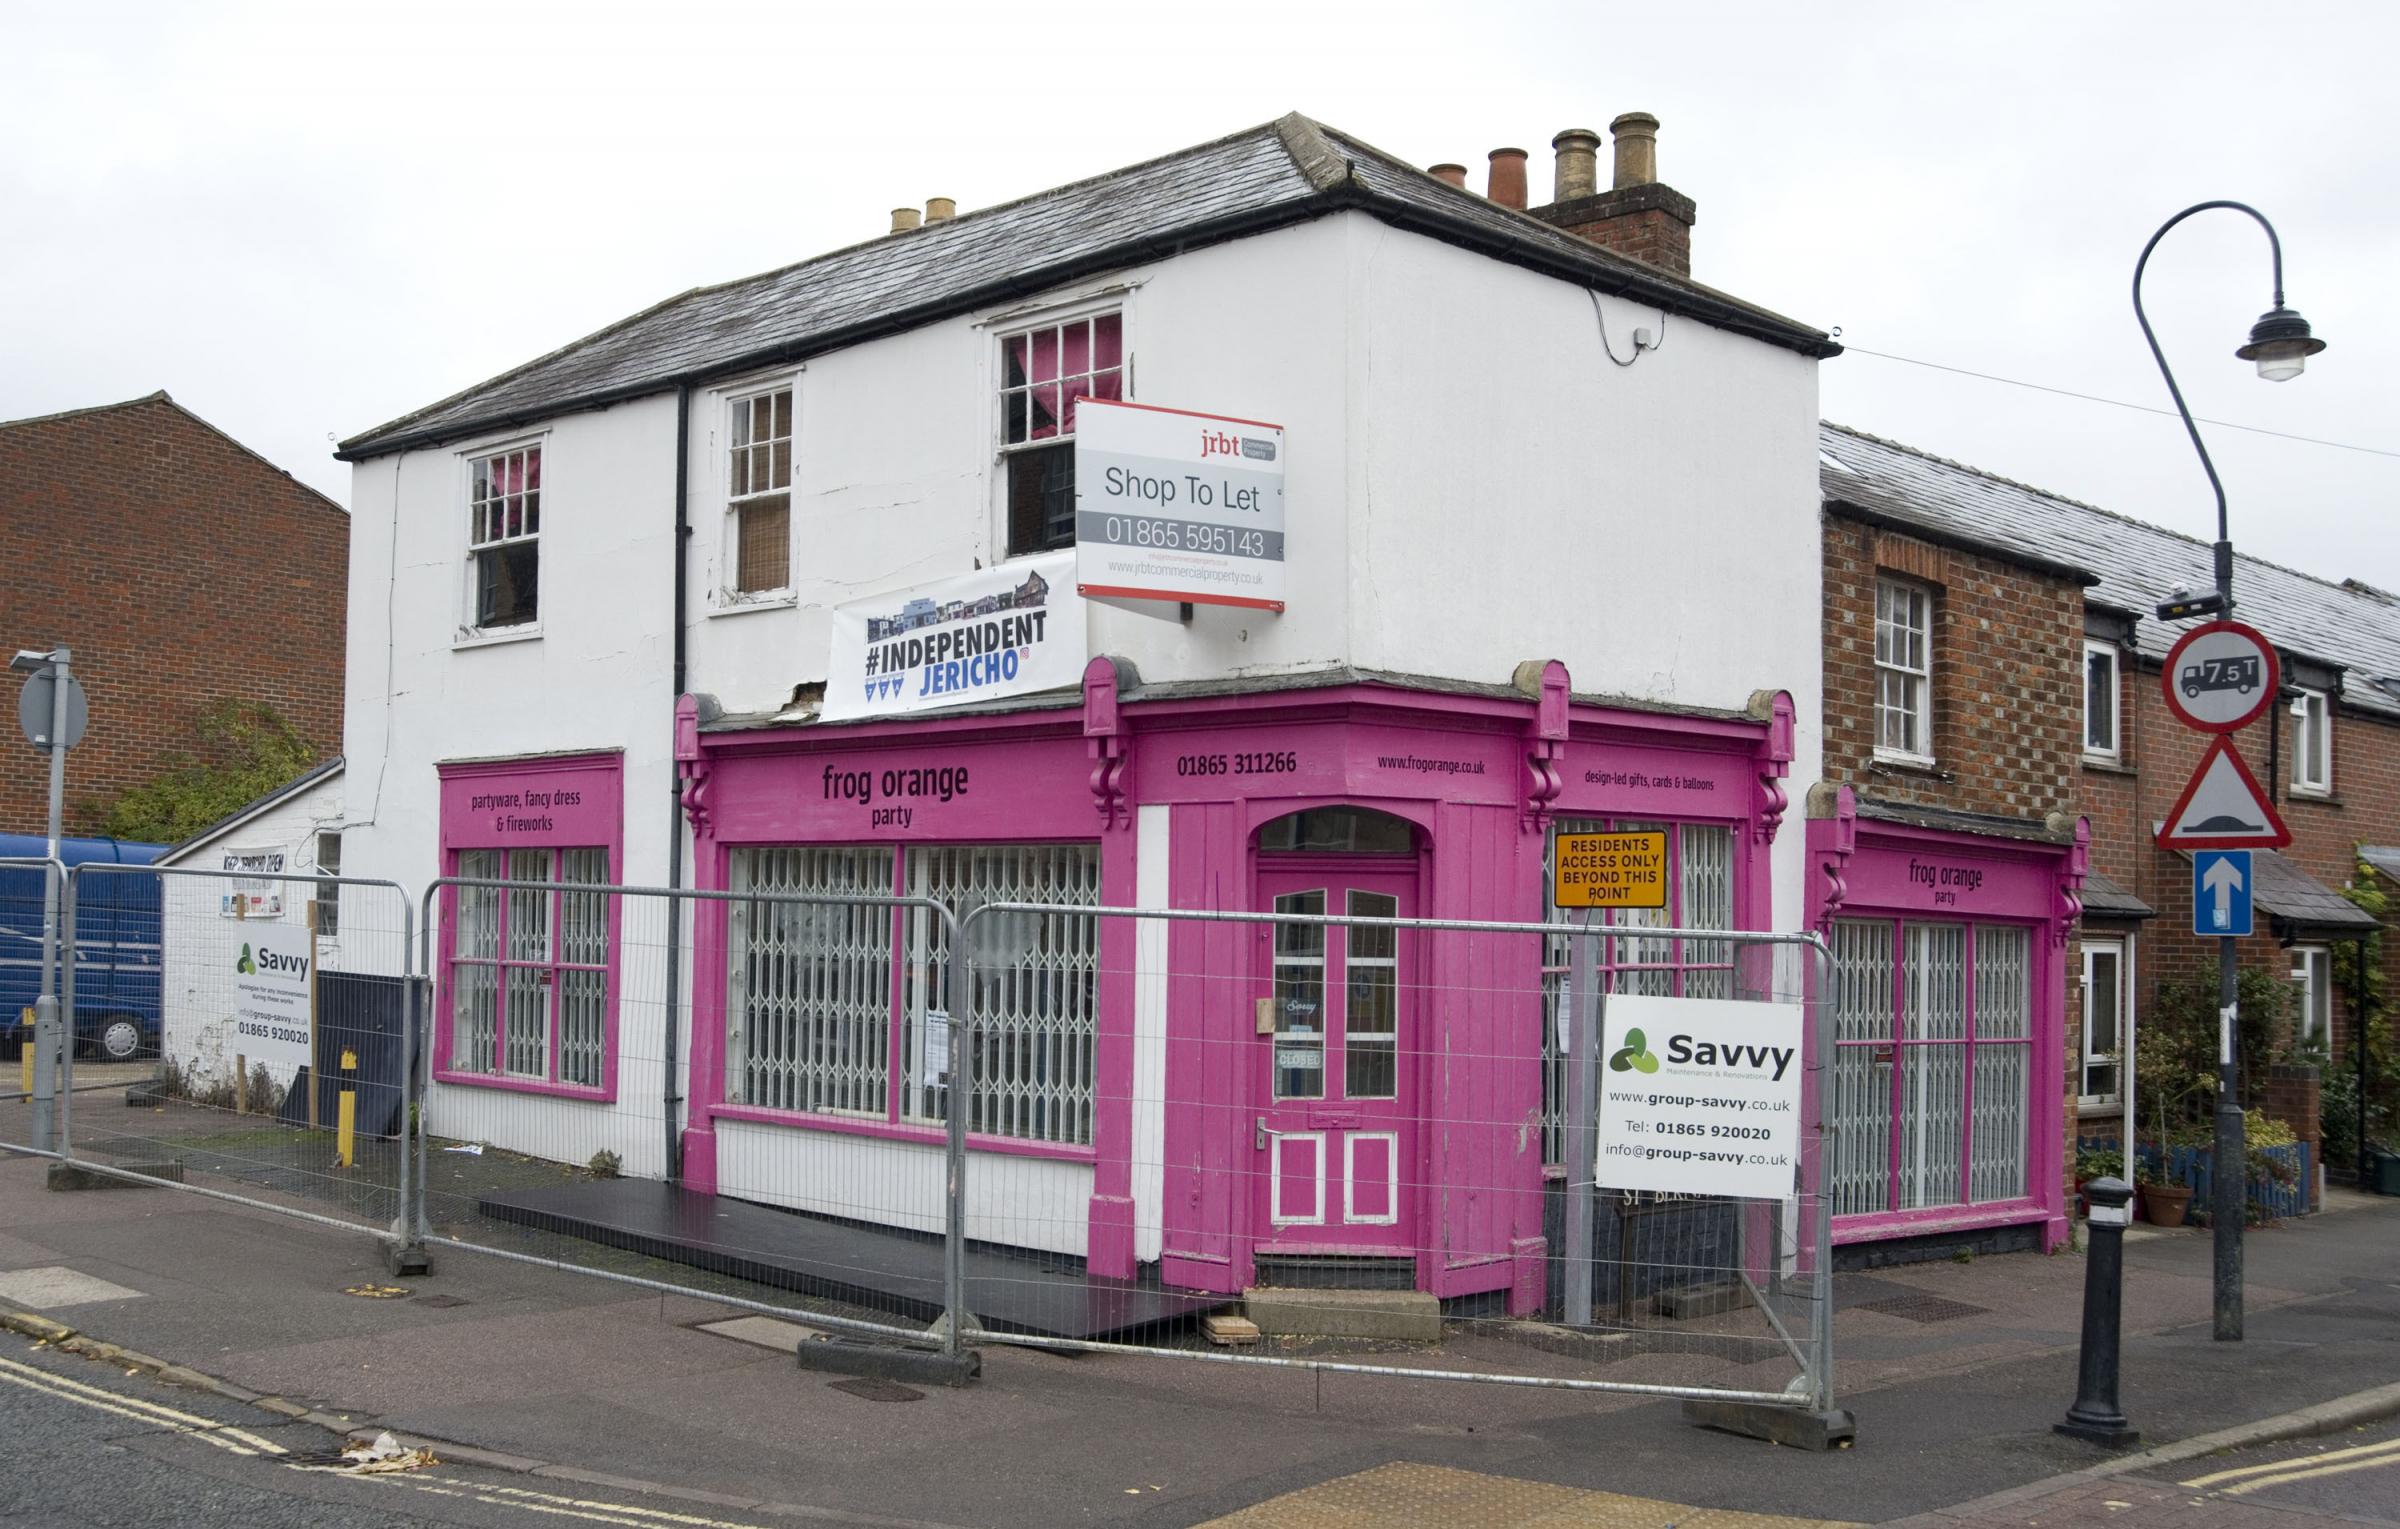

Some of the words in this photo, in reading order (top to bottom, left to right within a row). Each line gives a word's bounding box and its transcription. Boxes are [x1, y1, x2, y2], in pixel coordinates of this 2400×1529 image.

[1201, 430, 1240, 457] jrbt
[1106, 467, 1175, 507] Shop
[1185, 476, 1213, 505] To
[1224, 481, 1260, 512] Let
[1106, 517, 1179, 547] 01865
[1186, 526, 1264, 556] 595143
[1108, 560, 1263, 585] www.jrbtcommercialproperty.co.uk
[866, 610, 1046, 676] #INDEPENDENT
[919, 649, 1018, 696] JERICHO
[1177, 755, 1227, 776] 01865
[1234, 752, 1296, 774] 311266
[1378, 755, 1485, 774] www.frogorange.co.uk
[823, 764, 872, 805] frog
[882, 766, 968, 802] orange
[1585, 770, 1627, 785] design-led
[1629, 772, 1650, 788] gifts,
[1652, 776, 1672, 788] cards
[1674, 777, 1681, 789] &
[1683, 777, 1714, 791] balloons
[472, 793, 522, 812] partyware,
[525, 790, 551, 809] fancy
[554, 789, 580, 806] dress
[497, 816, 504, 832] &
[507, 814, 552, 832] fireworks
[872, 806, 912, 829] party
[1571, 839, 1649, 852] RESIDENTS
[266, 853, 284, 872] OPEN
[1561, 855, 1617, 868] ACCESS
[1622, 854, 1659, 867] ONLY
[1563, 871, 1620, 884] BEYOND
[1625, 870, 1657, 883] THIS
[1909, 858, 1936, 888] frog
[1941, 867, 1982, 891] orange
[1588, 886, 1631, 900] POINT
[1935, 890, 1956, 906] party
[259, 948, 309, 982] Savvy
[1287, 1000, 1316, 1014] Sorry
[239, 1022, 269, 1037] 01865
[272, 1027, 308, 1044] 920020
[1280, 1054, 1320, 1065] CLOSED
[1667, 1034, 1794, 1081] Savvy
[1666, 1068, 1712, 1077] Maintenance
[1723, 1072, 1768, 1080] Renovations
[1609, 1091, 1790, 1112] www.group-savvy.co.uk
[1625, 1120, 1650, 1133] Tel:
[1656, 1122, 1705, 1136] 01865
[1711, 1126, 1771, 1140] 920020
[1606, 1144, 1788, 1166] info@group-savvy.co.uk
